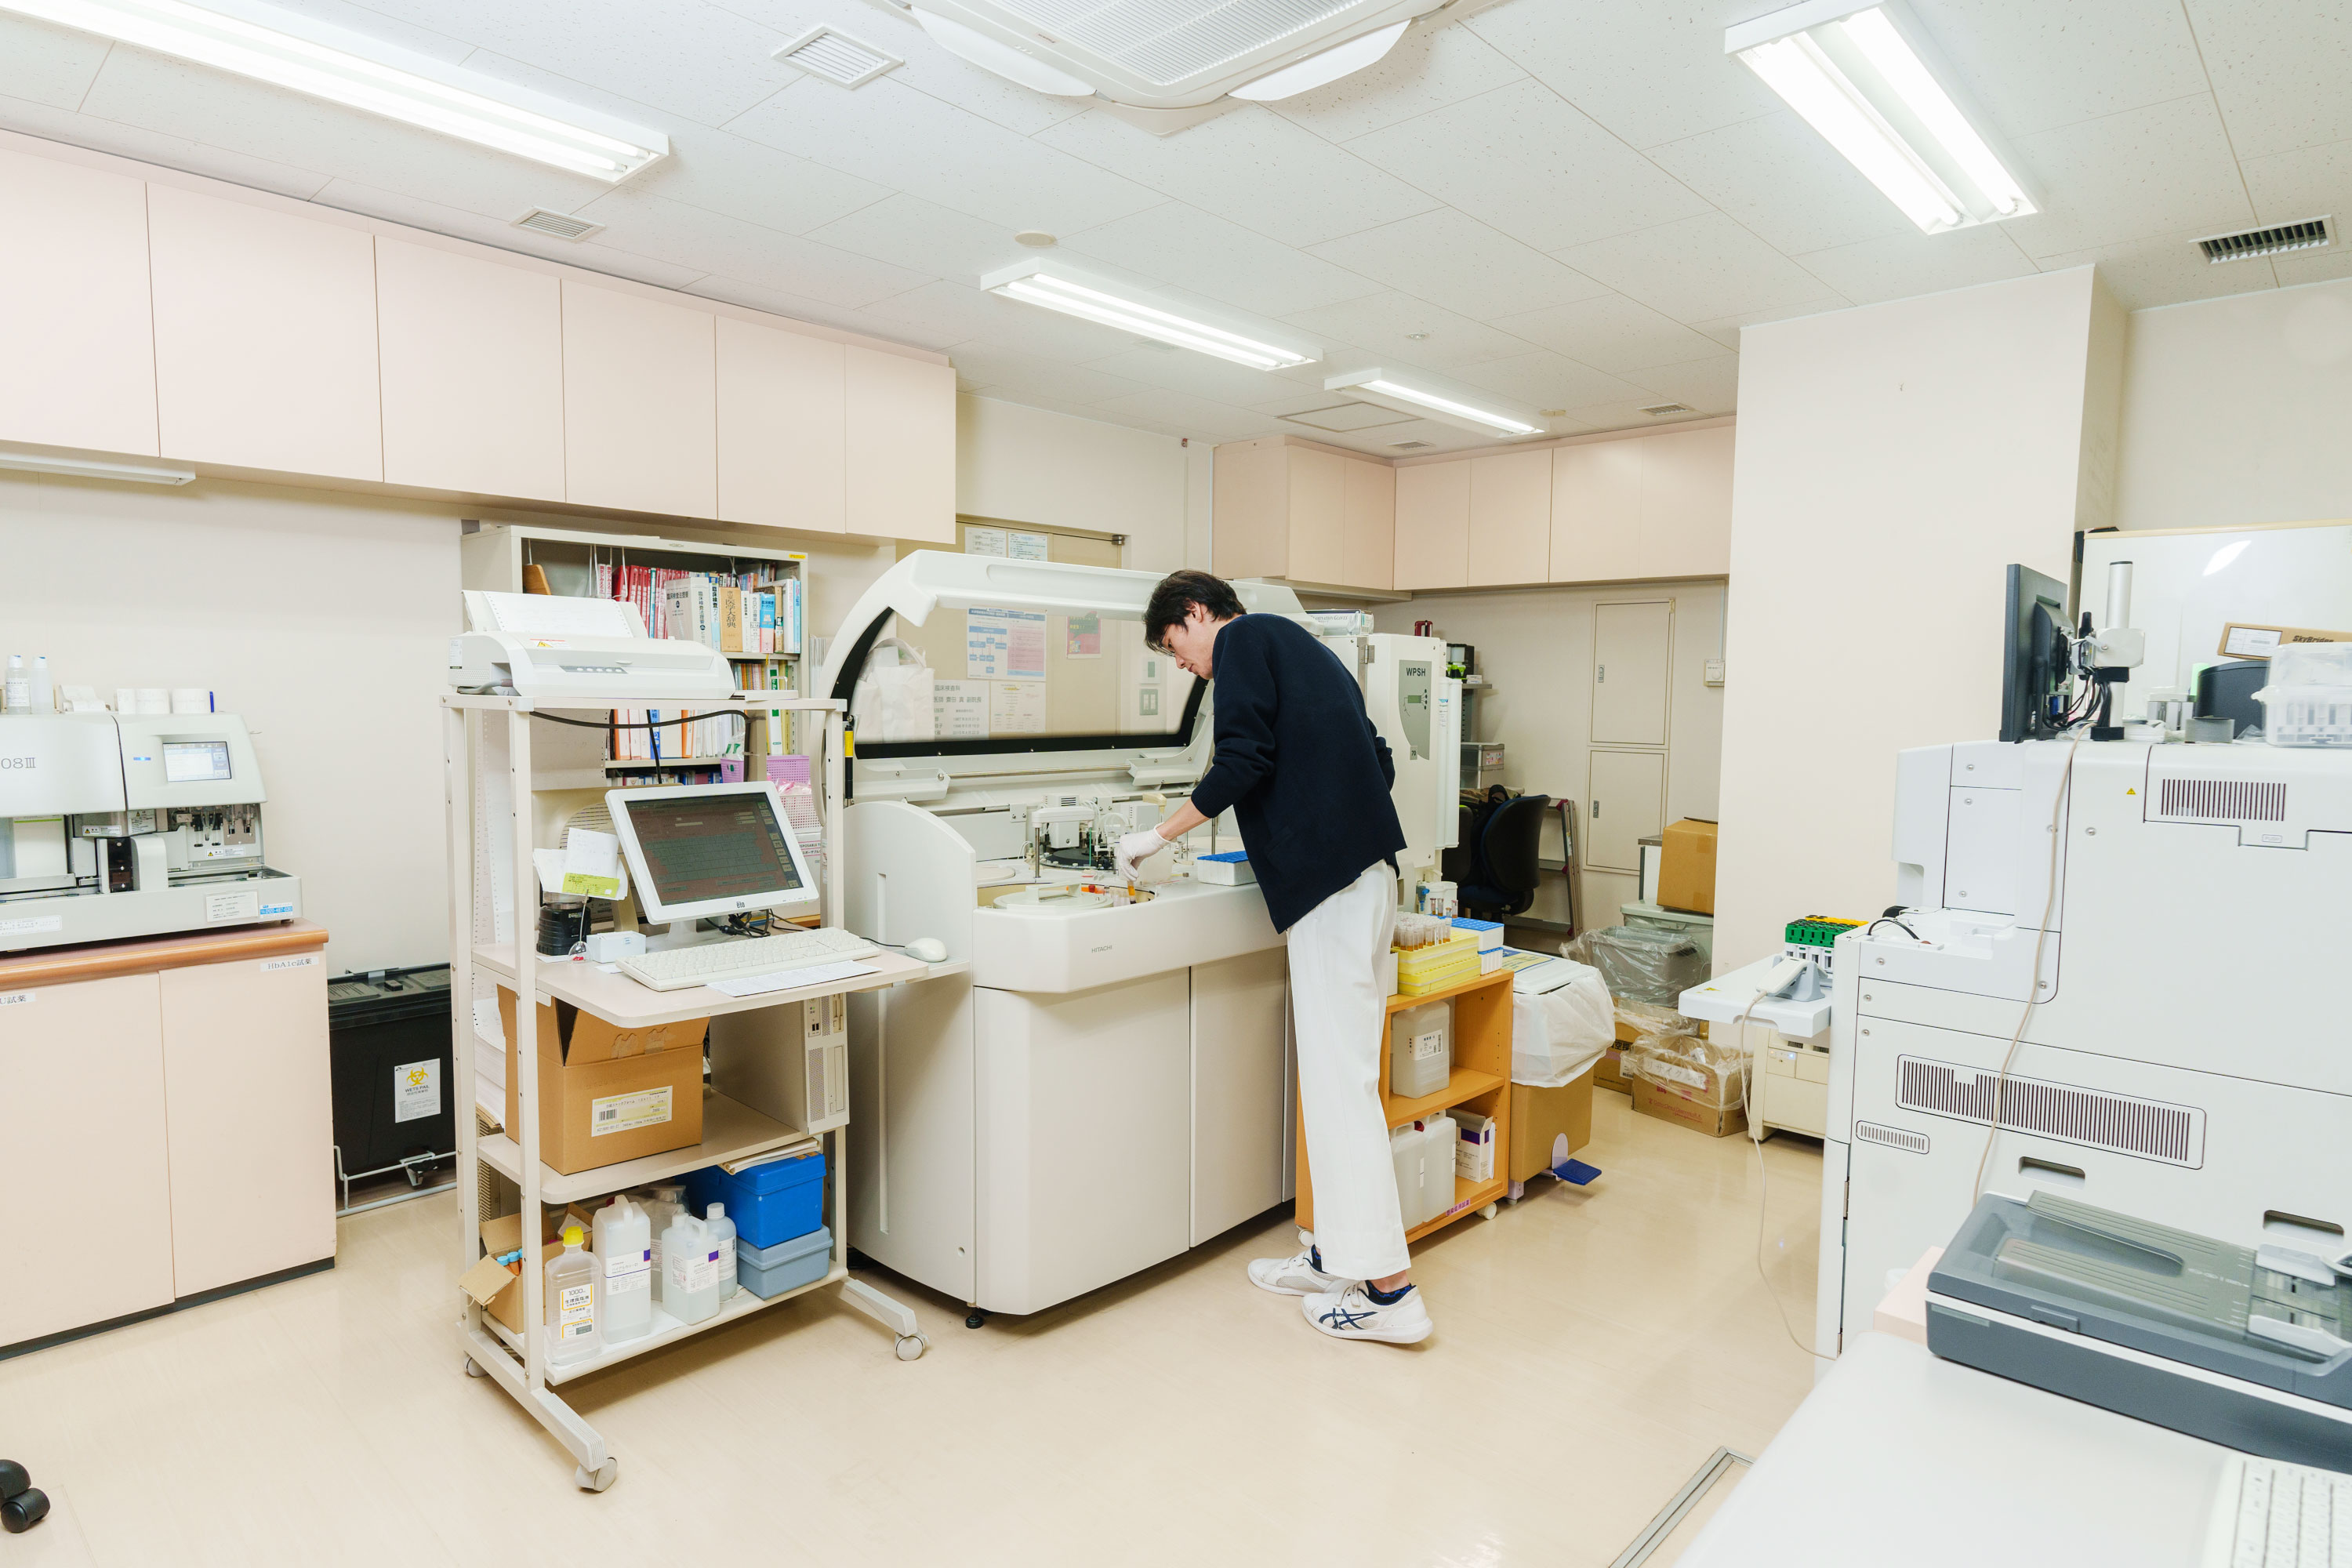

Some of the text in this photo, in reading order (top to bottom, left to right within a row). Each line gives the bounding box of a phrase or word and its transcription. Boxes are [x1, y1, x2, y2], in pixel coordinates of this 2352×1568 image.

[1406, 667, 1426, 677] WPSH
[1091, 945, 1112, 953] HITACHI
[267, 957, 313, 970] HbA1c試薬
